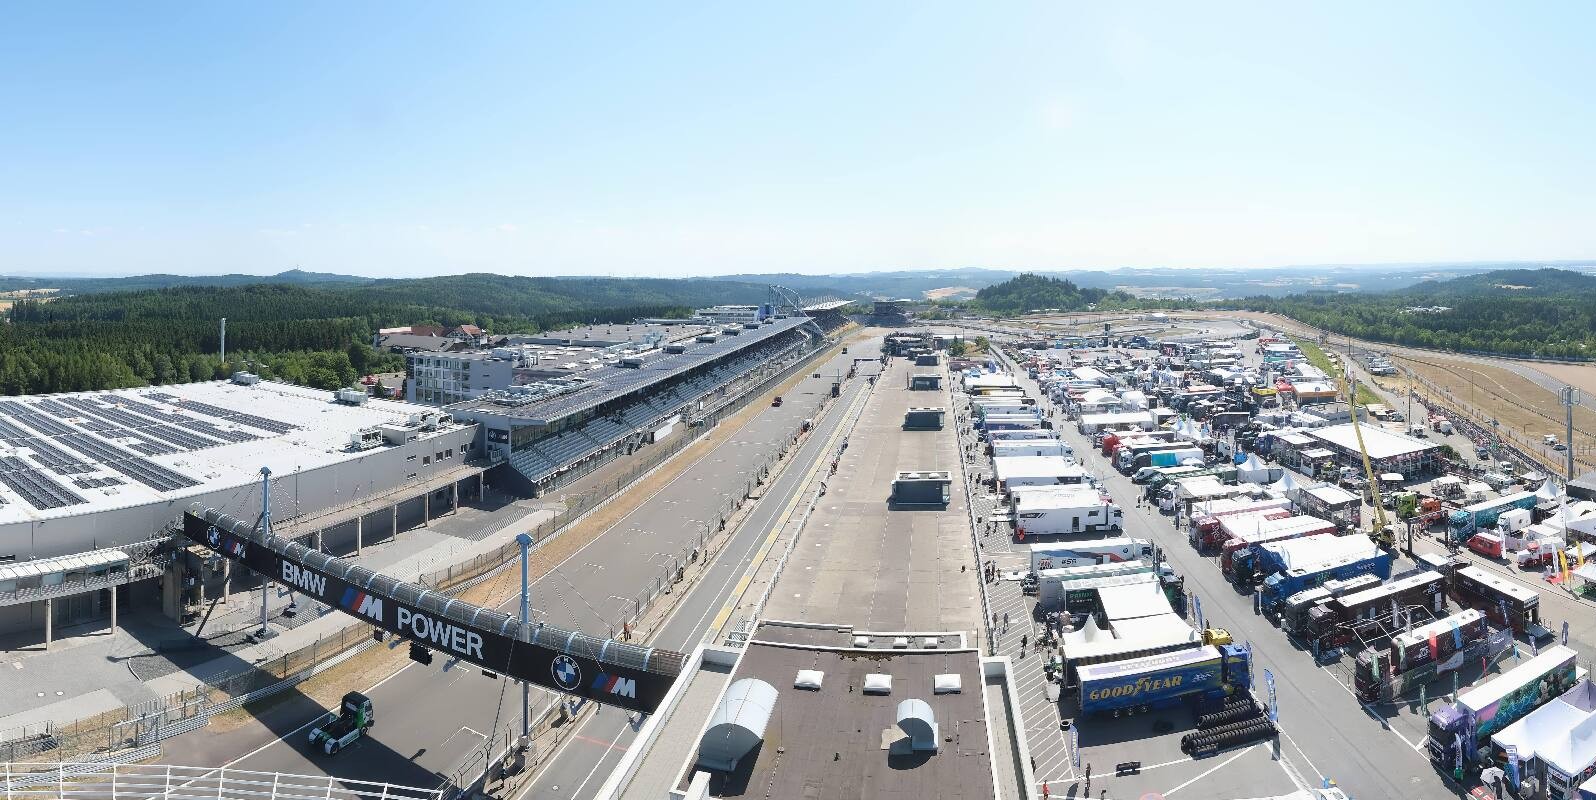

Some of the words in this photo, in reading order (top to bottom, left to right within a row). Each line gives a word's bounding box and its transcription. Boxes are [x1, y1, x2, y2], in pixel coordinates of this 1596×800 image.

[282, 561, 328, 597] BMW
[397, 606, 484, 661] POWER
[1089, 675, 1184, 701] GOODYEAR
